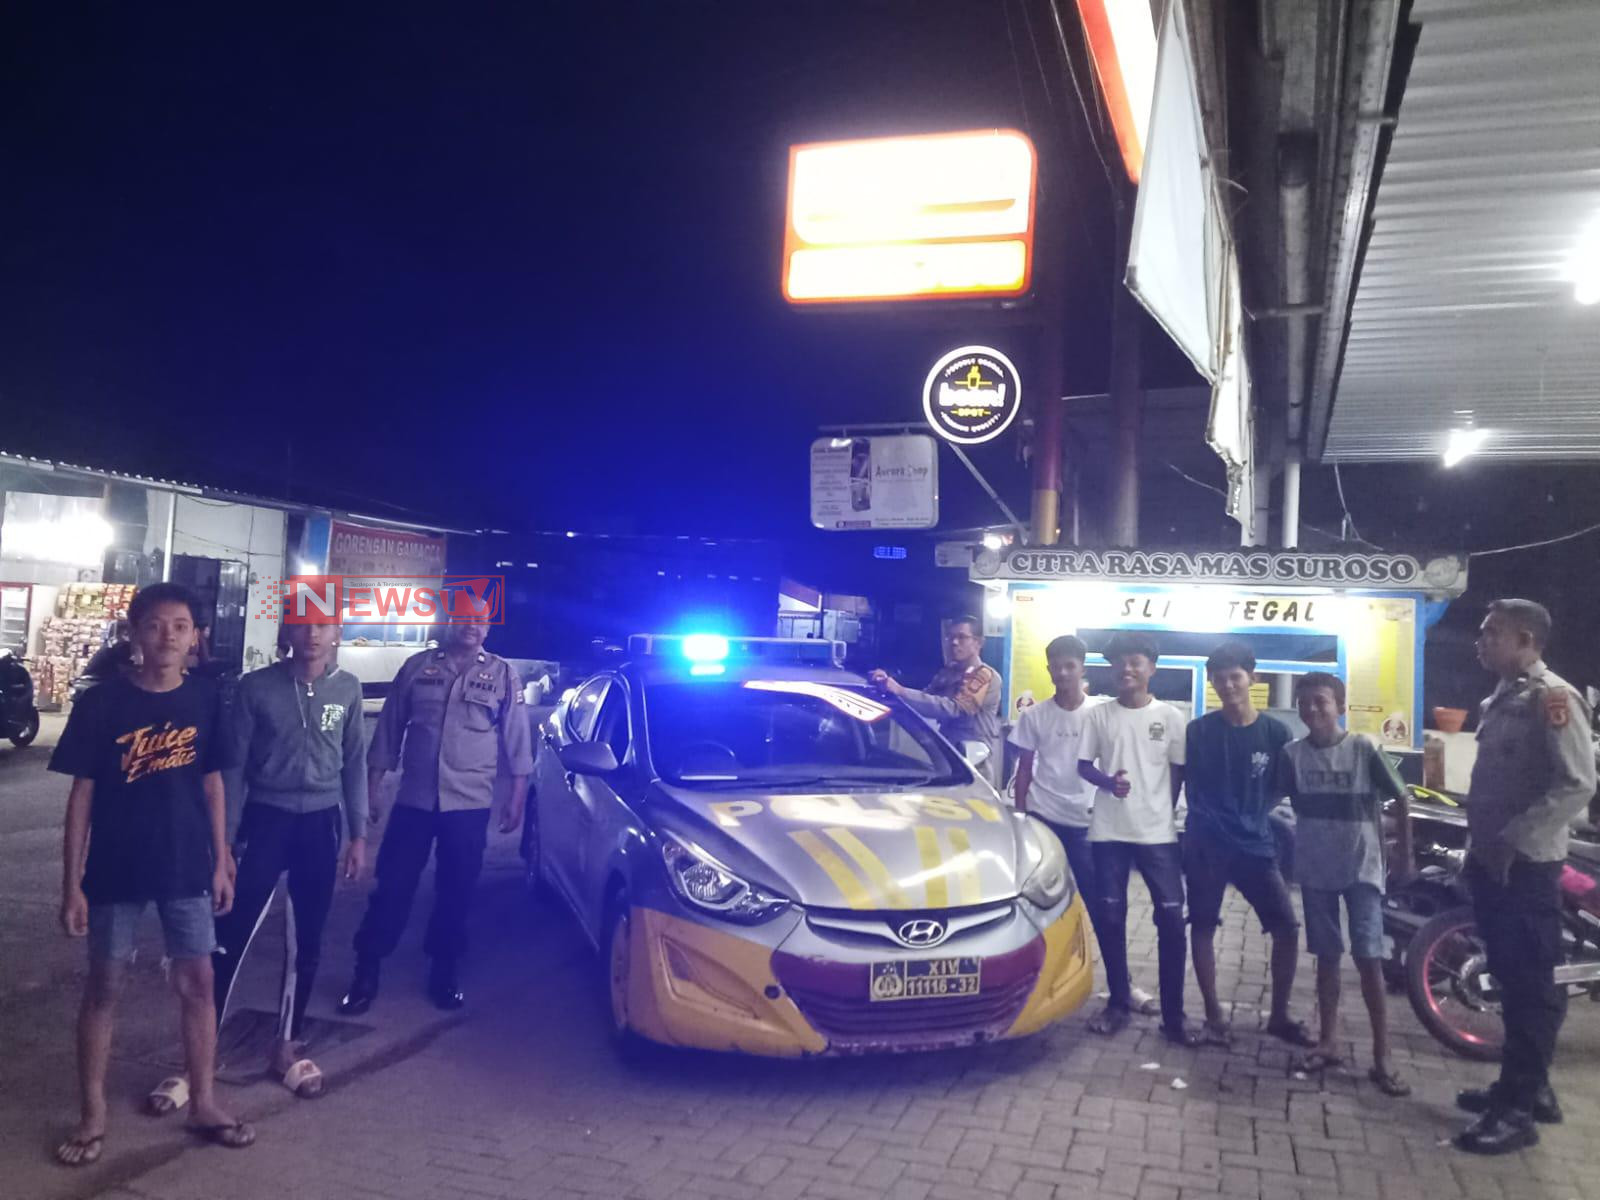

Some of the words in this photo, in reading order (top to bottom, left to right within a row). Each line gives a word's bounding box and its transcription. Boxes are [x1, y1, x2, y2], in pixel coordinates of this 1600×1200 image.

[1011, 554, 1100, 576] CITRA
[1106, 555, 1192, 577] RASA
[1199, 556, 1268, 578] MAS
[1273, 556, 1415, 582] SUROSO
[1229, 601, 1315, 622] TEGAL
[929, 960, 958, 976] XIV
